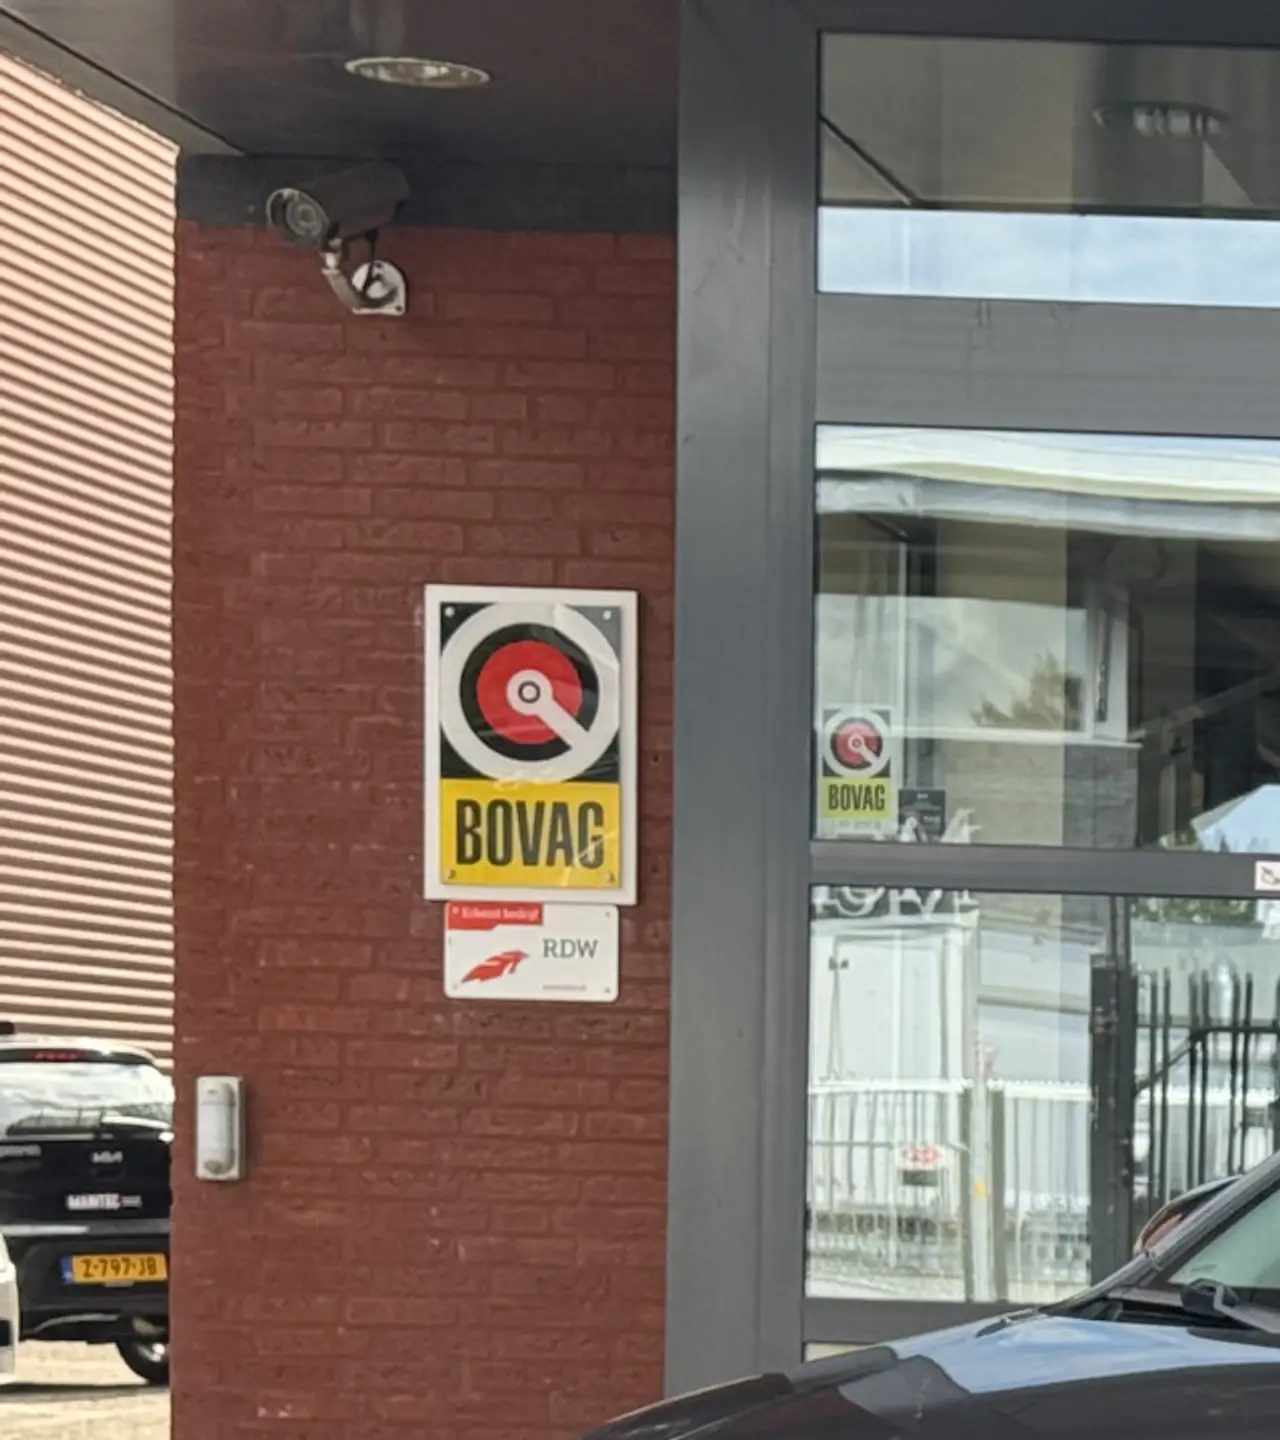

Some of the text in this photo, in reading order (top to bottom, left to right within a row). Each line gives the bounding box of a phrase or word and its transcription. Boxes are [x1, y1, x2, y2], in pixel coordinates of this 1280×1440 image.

[827, 784, 885, 812] BOVAG
[456, 798, 604, 869] BOVAG
[542, 938, 598, 959] RDW
